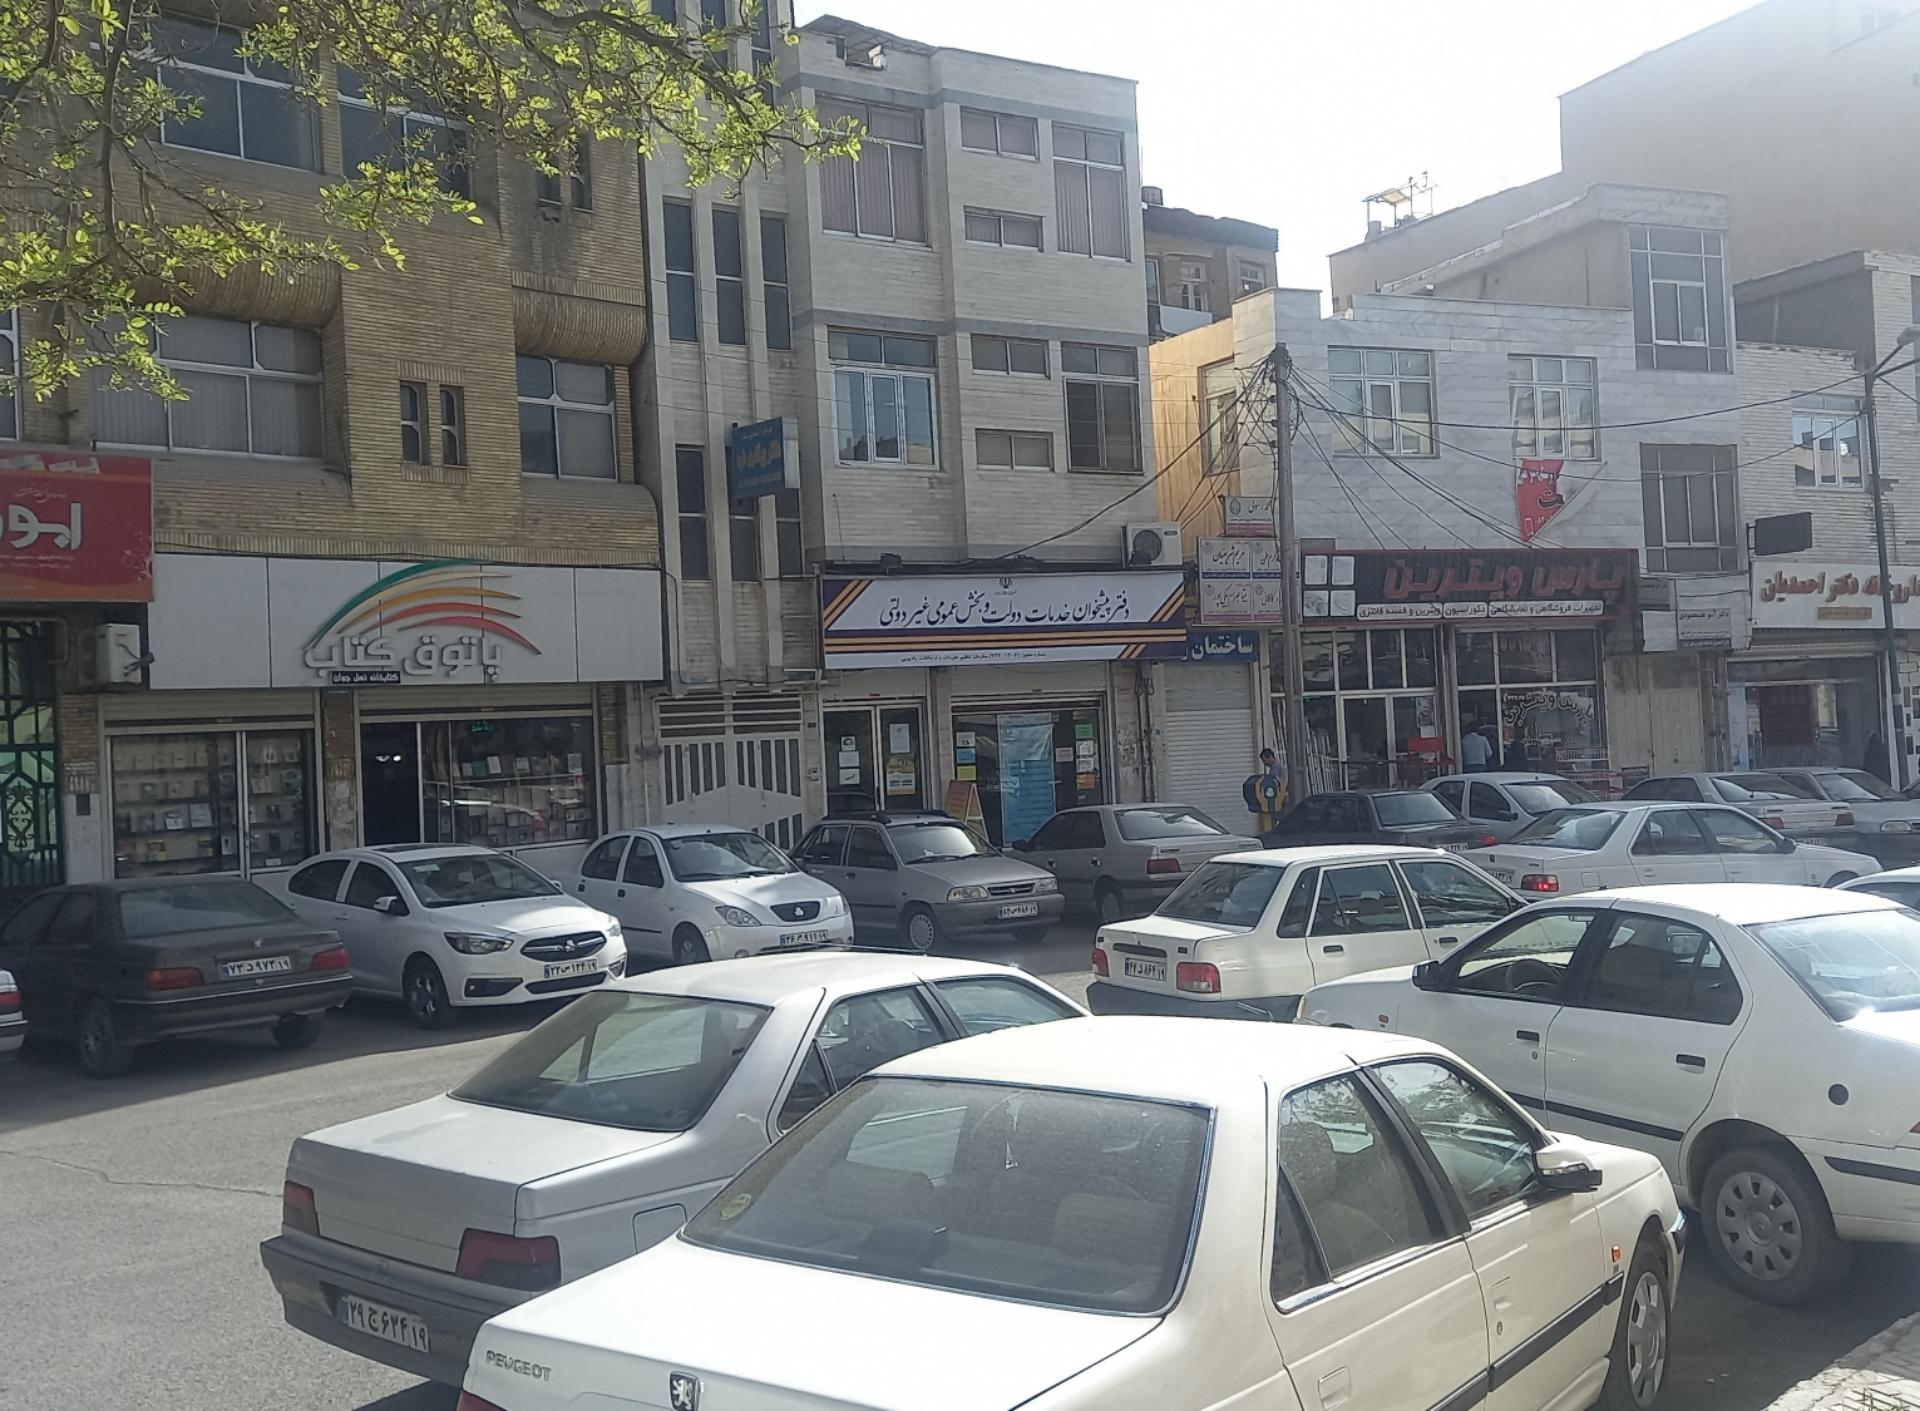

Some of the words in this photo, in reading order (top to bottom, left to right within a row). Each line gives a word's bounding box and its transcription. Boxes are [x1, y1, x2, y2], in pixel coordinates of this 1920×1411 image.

[1024, 602, 1071, 623] خدمات
[304, 635, 397, 678] کتاب
[486, 1350, 552, 1382] PEUGEOT
